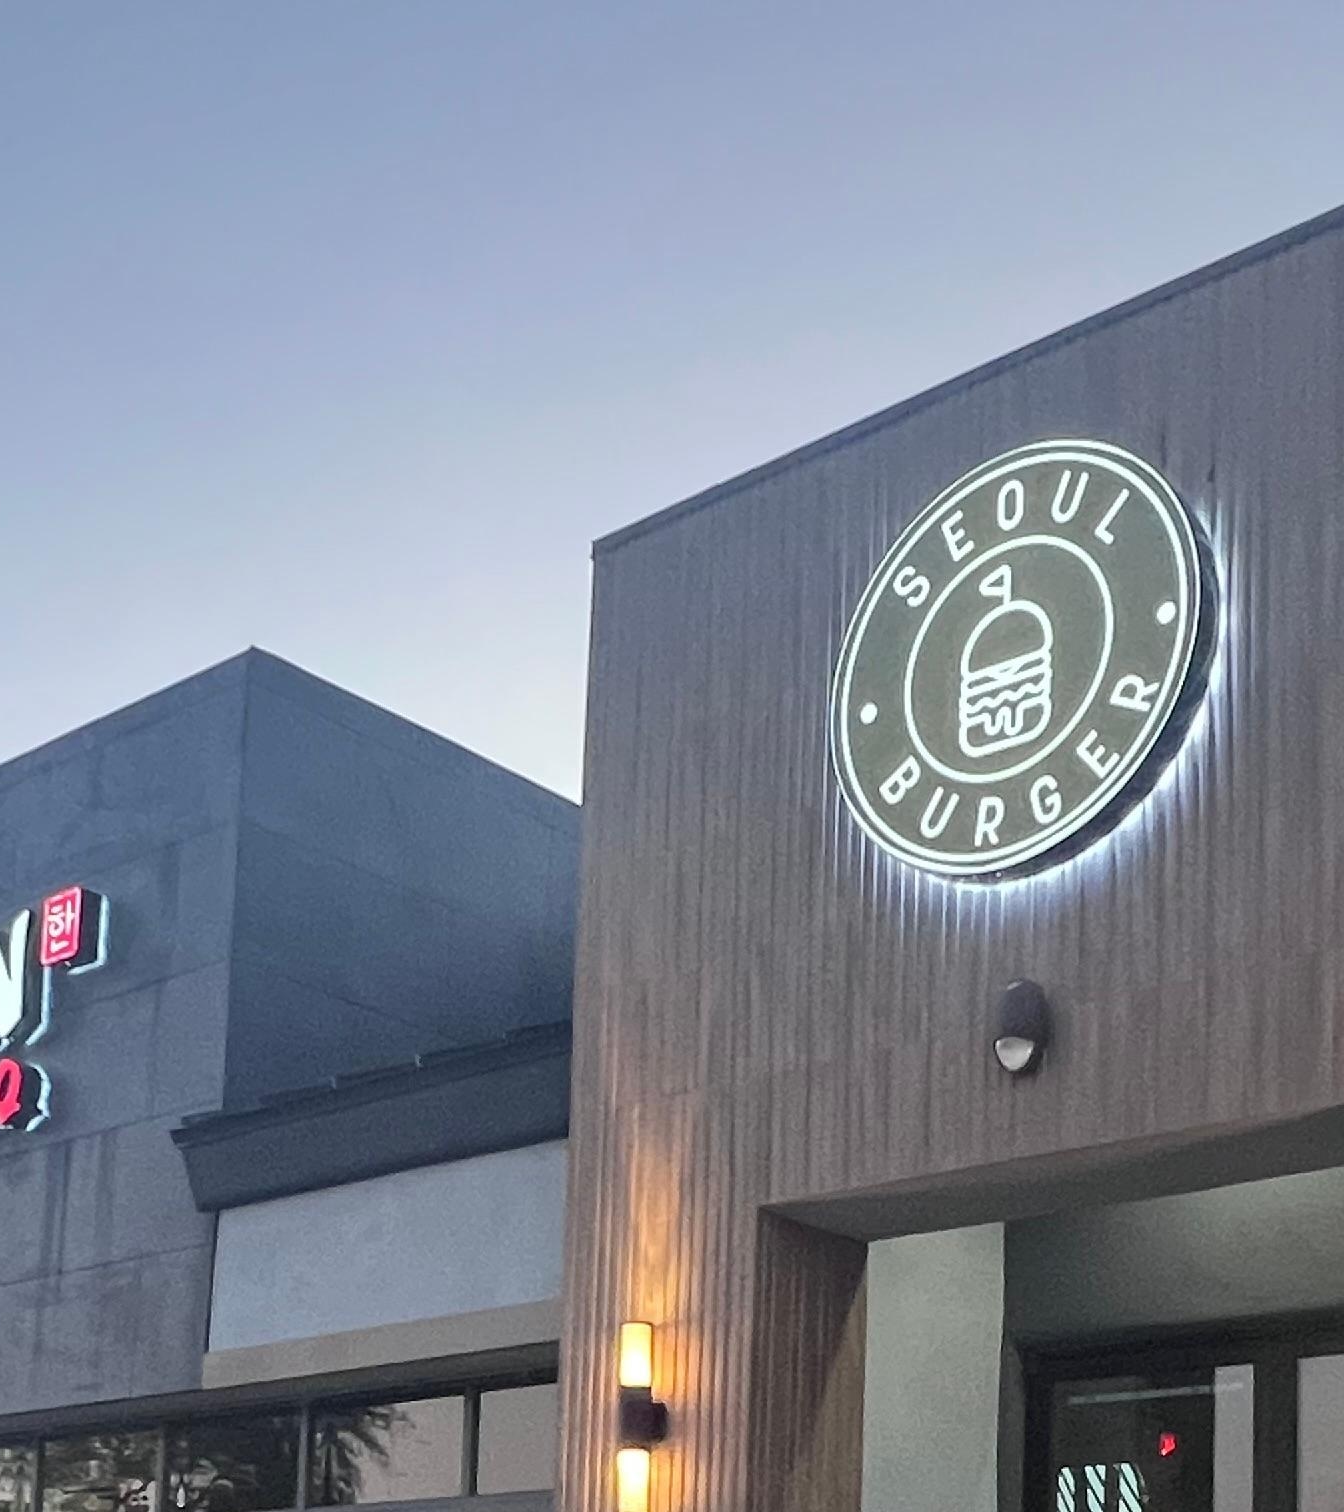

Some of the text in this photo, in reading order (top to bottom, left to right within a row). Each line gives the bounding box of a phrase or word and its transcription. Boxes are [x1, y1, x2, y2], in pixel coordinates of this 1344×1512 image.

[893, 470, 1130, 608] SEOUL
[878, 673, 1160, 848] BURGER
[47, 899, 76, 954] 한
